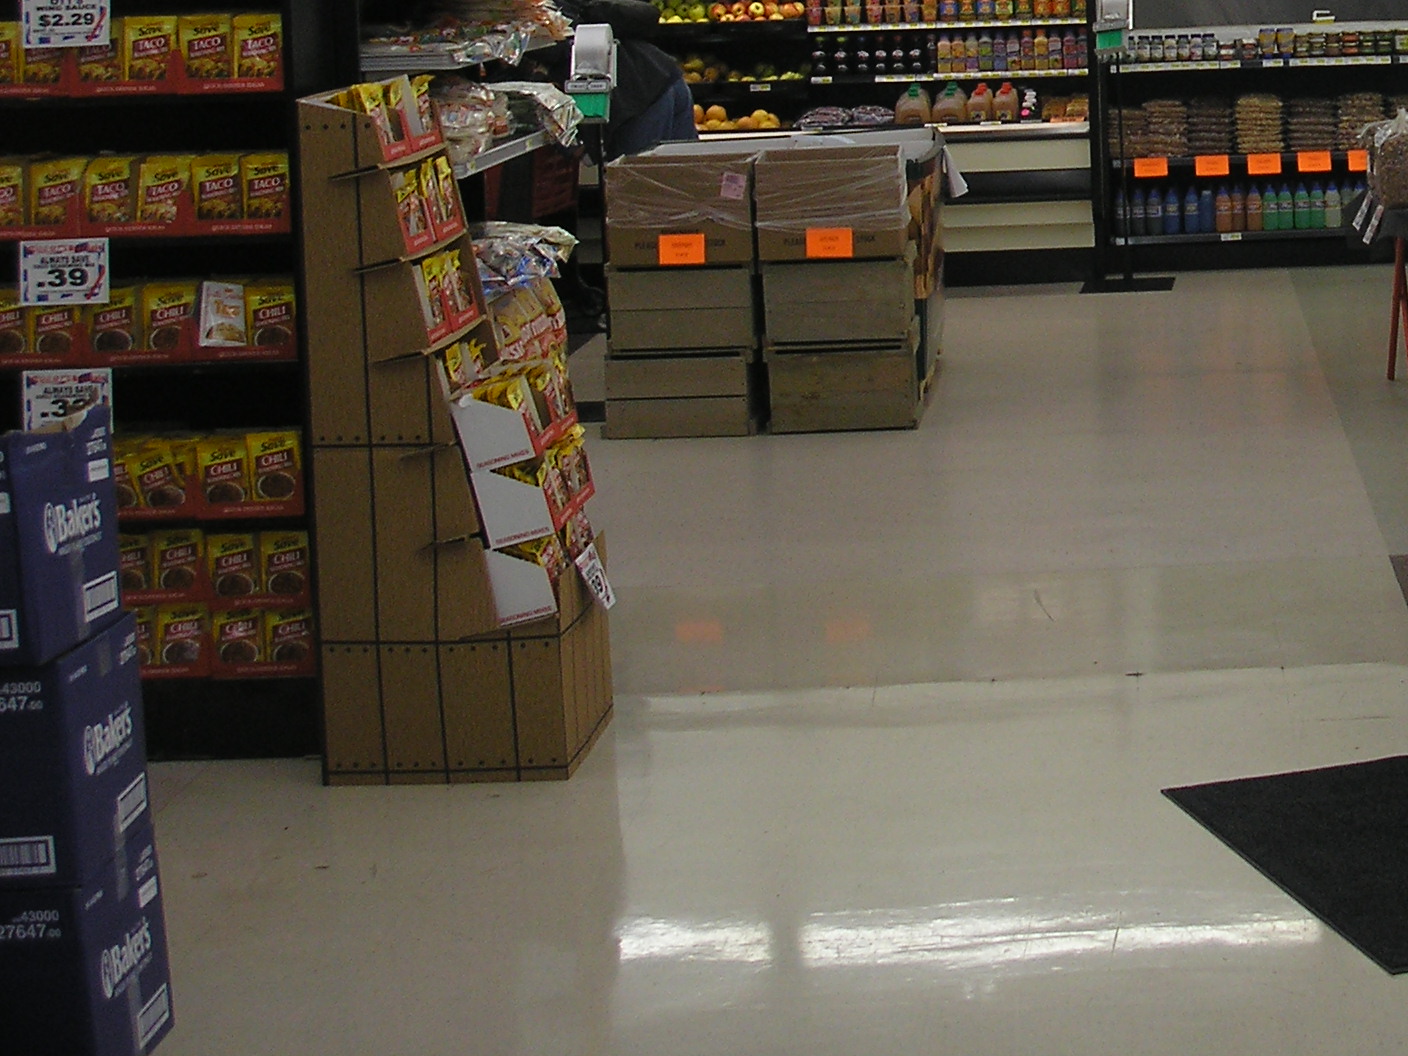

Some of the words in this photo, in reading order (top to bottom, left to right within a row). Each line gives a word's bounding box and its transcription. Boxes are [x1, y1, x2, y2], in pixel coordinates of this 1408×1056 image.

[38, 13, 94, 27] $2.29
[137, 36, 166, 49] TACO
[194, 36, 222, 49] TACO
[249, 36, 275, 49] TACO
[206, 168, 232, 177] Save
[98, 183, 125, 194] TACO
[206, 178, 233, 192] TACO
[254, 177, 280, 188] TACO
[44, 184, 72, 196] TACO
[152, 183, 179, 196] TACO
[40, 256, 69, 264] ALWAYS
[71, 255, 90, 264] SAVE
[36, 268, 88, 288] .39
[42, 312, 68, 324] CHILI
[99, 310, 126, 323] CHILI
[156, 306, 184, 321] CHILI
[260, 306, 286, 320] CHILI
[44, 386, 72, 394] ALWAYS
[260, 452, 288, 466] CHILI
[476, 454, 510, 469] SEASONING
[510, 449, 530, 460] MIXES
[210, 462, 238, 475] CHILI
[496, 531, 530, 546] SEASONING
[530, 526, 550, 536] MIXES
[166, 546, 193, 560] CHILI
[274, 551, 300, 564] CHILI
[222, 554, 247, 567] CHILI
[532, 605, 552, 616] MIXES
[21, 910, 60, 923] 43000
